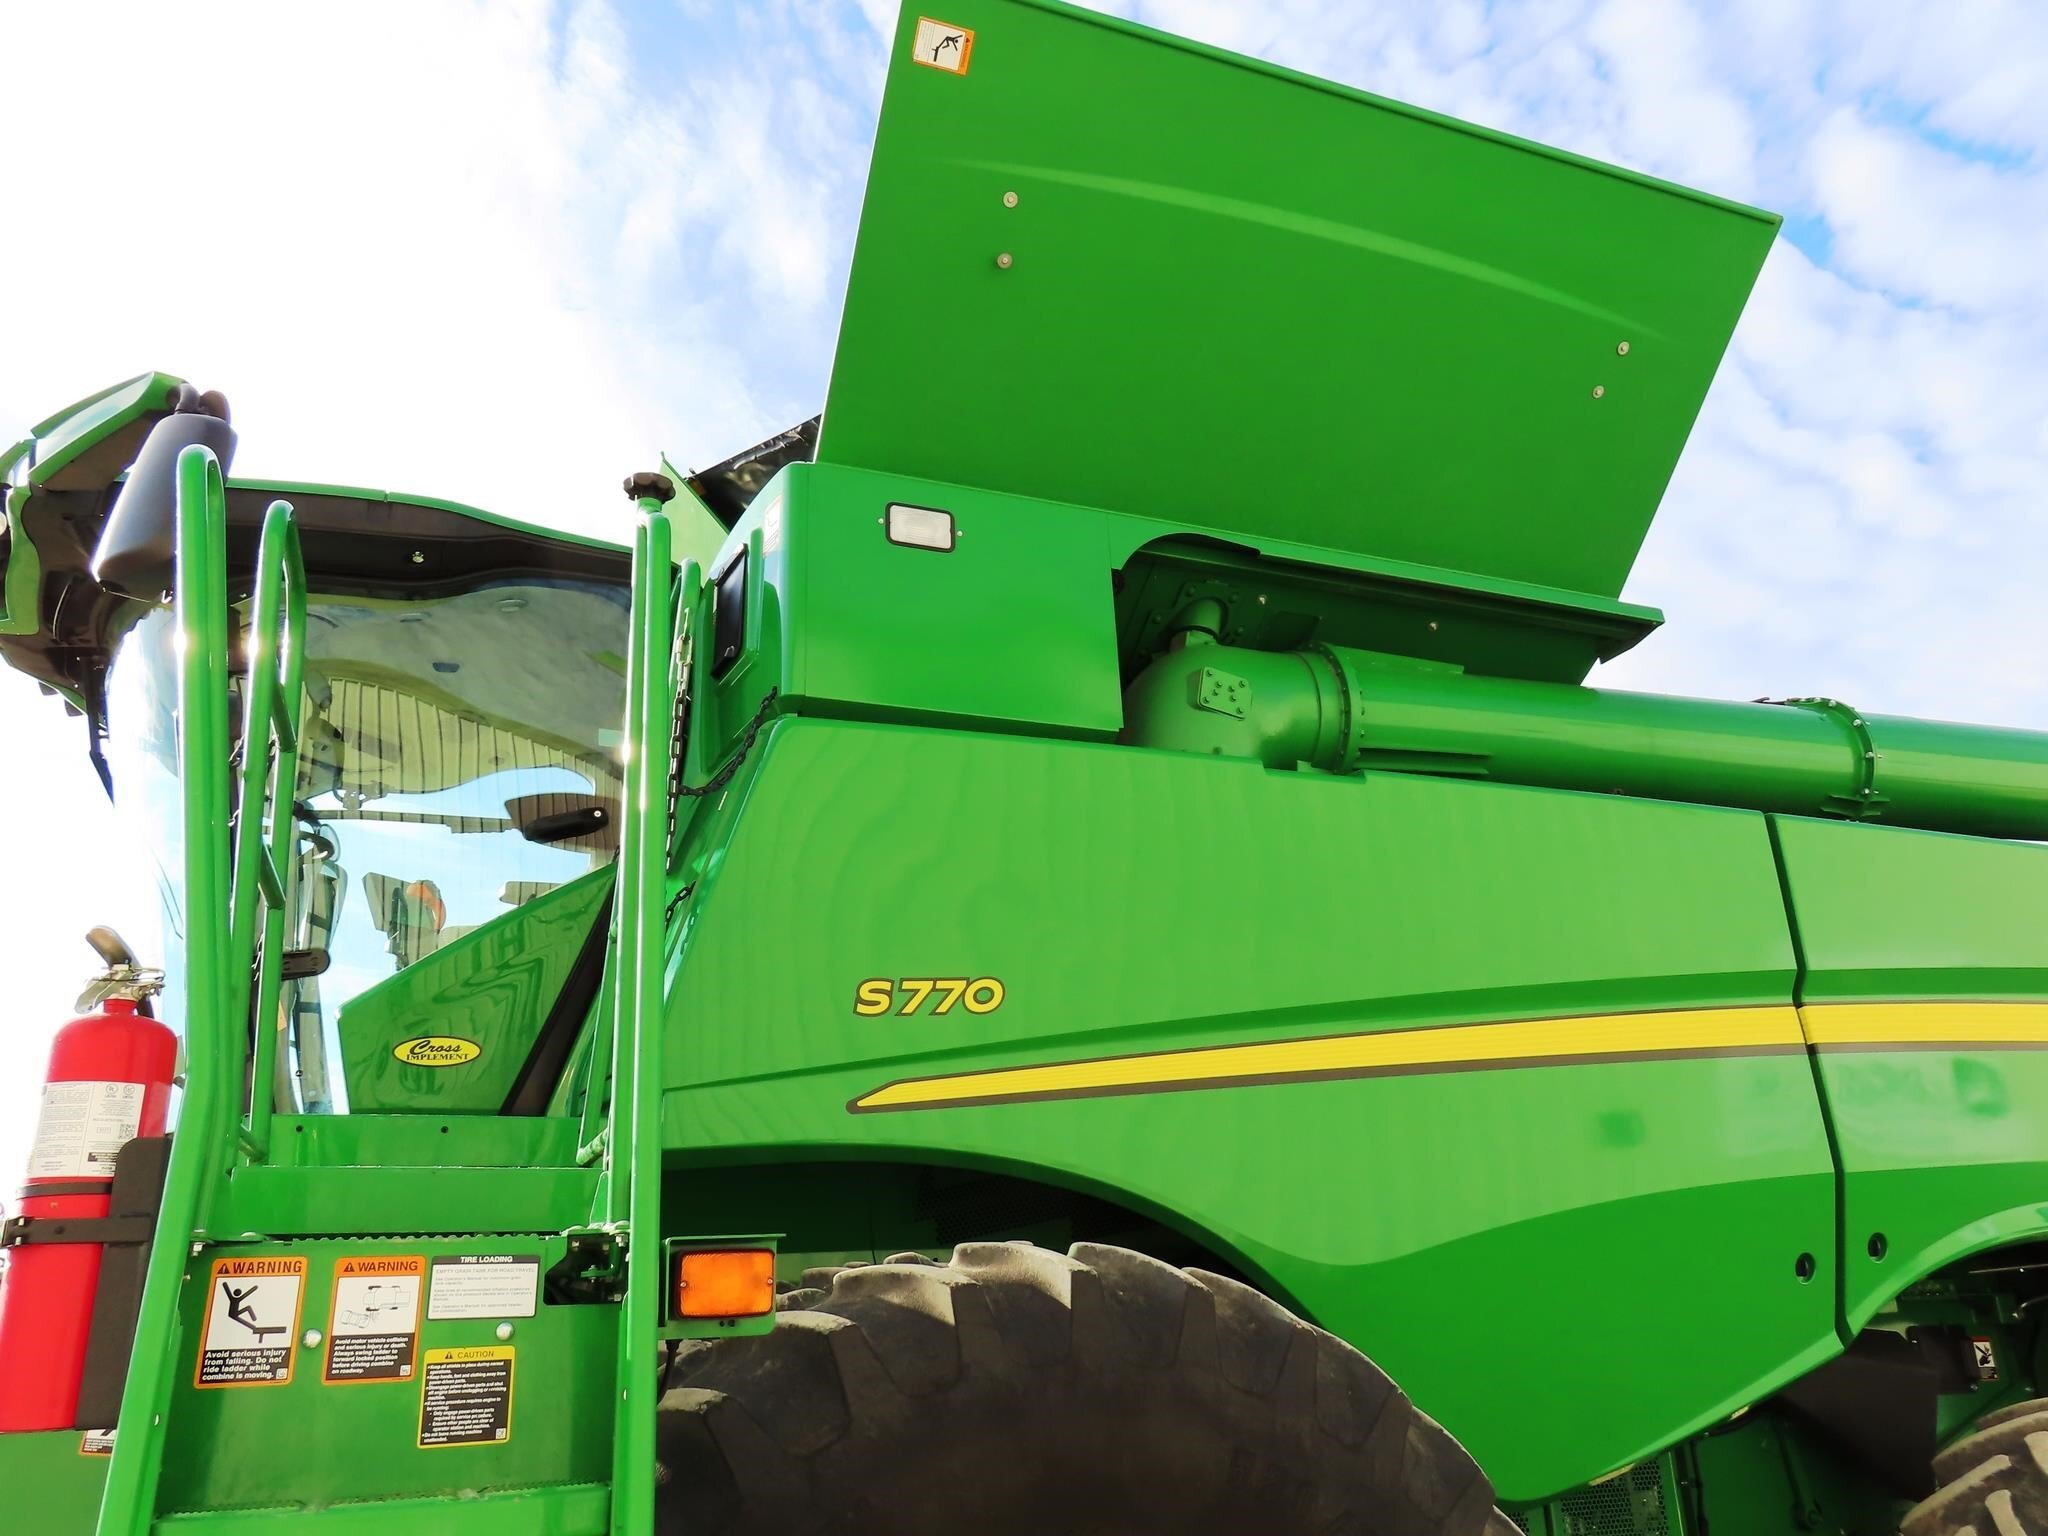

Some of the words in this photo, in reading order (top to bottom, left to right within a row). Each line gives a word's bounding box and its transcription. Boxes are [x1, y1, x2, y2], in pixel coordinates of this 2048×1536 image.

[853, 976, 1005, 1017] S770
[409, 1040, 461, 1055] Cross
[479, 1255, 513, 1263] LOADING
[232, 1260, 302, 1275] WARNING
[357, 1260, 418, 1272] WARNING
[263, 1349, 286, 1358] injury
[457, 1351, 494, 1359] CAUTION
[225, 1358, 253, 1366] falling.
[244, 1371, 274, 1380] moving.
